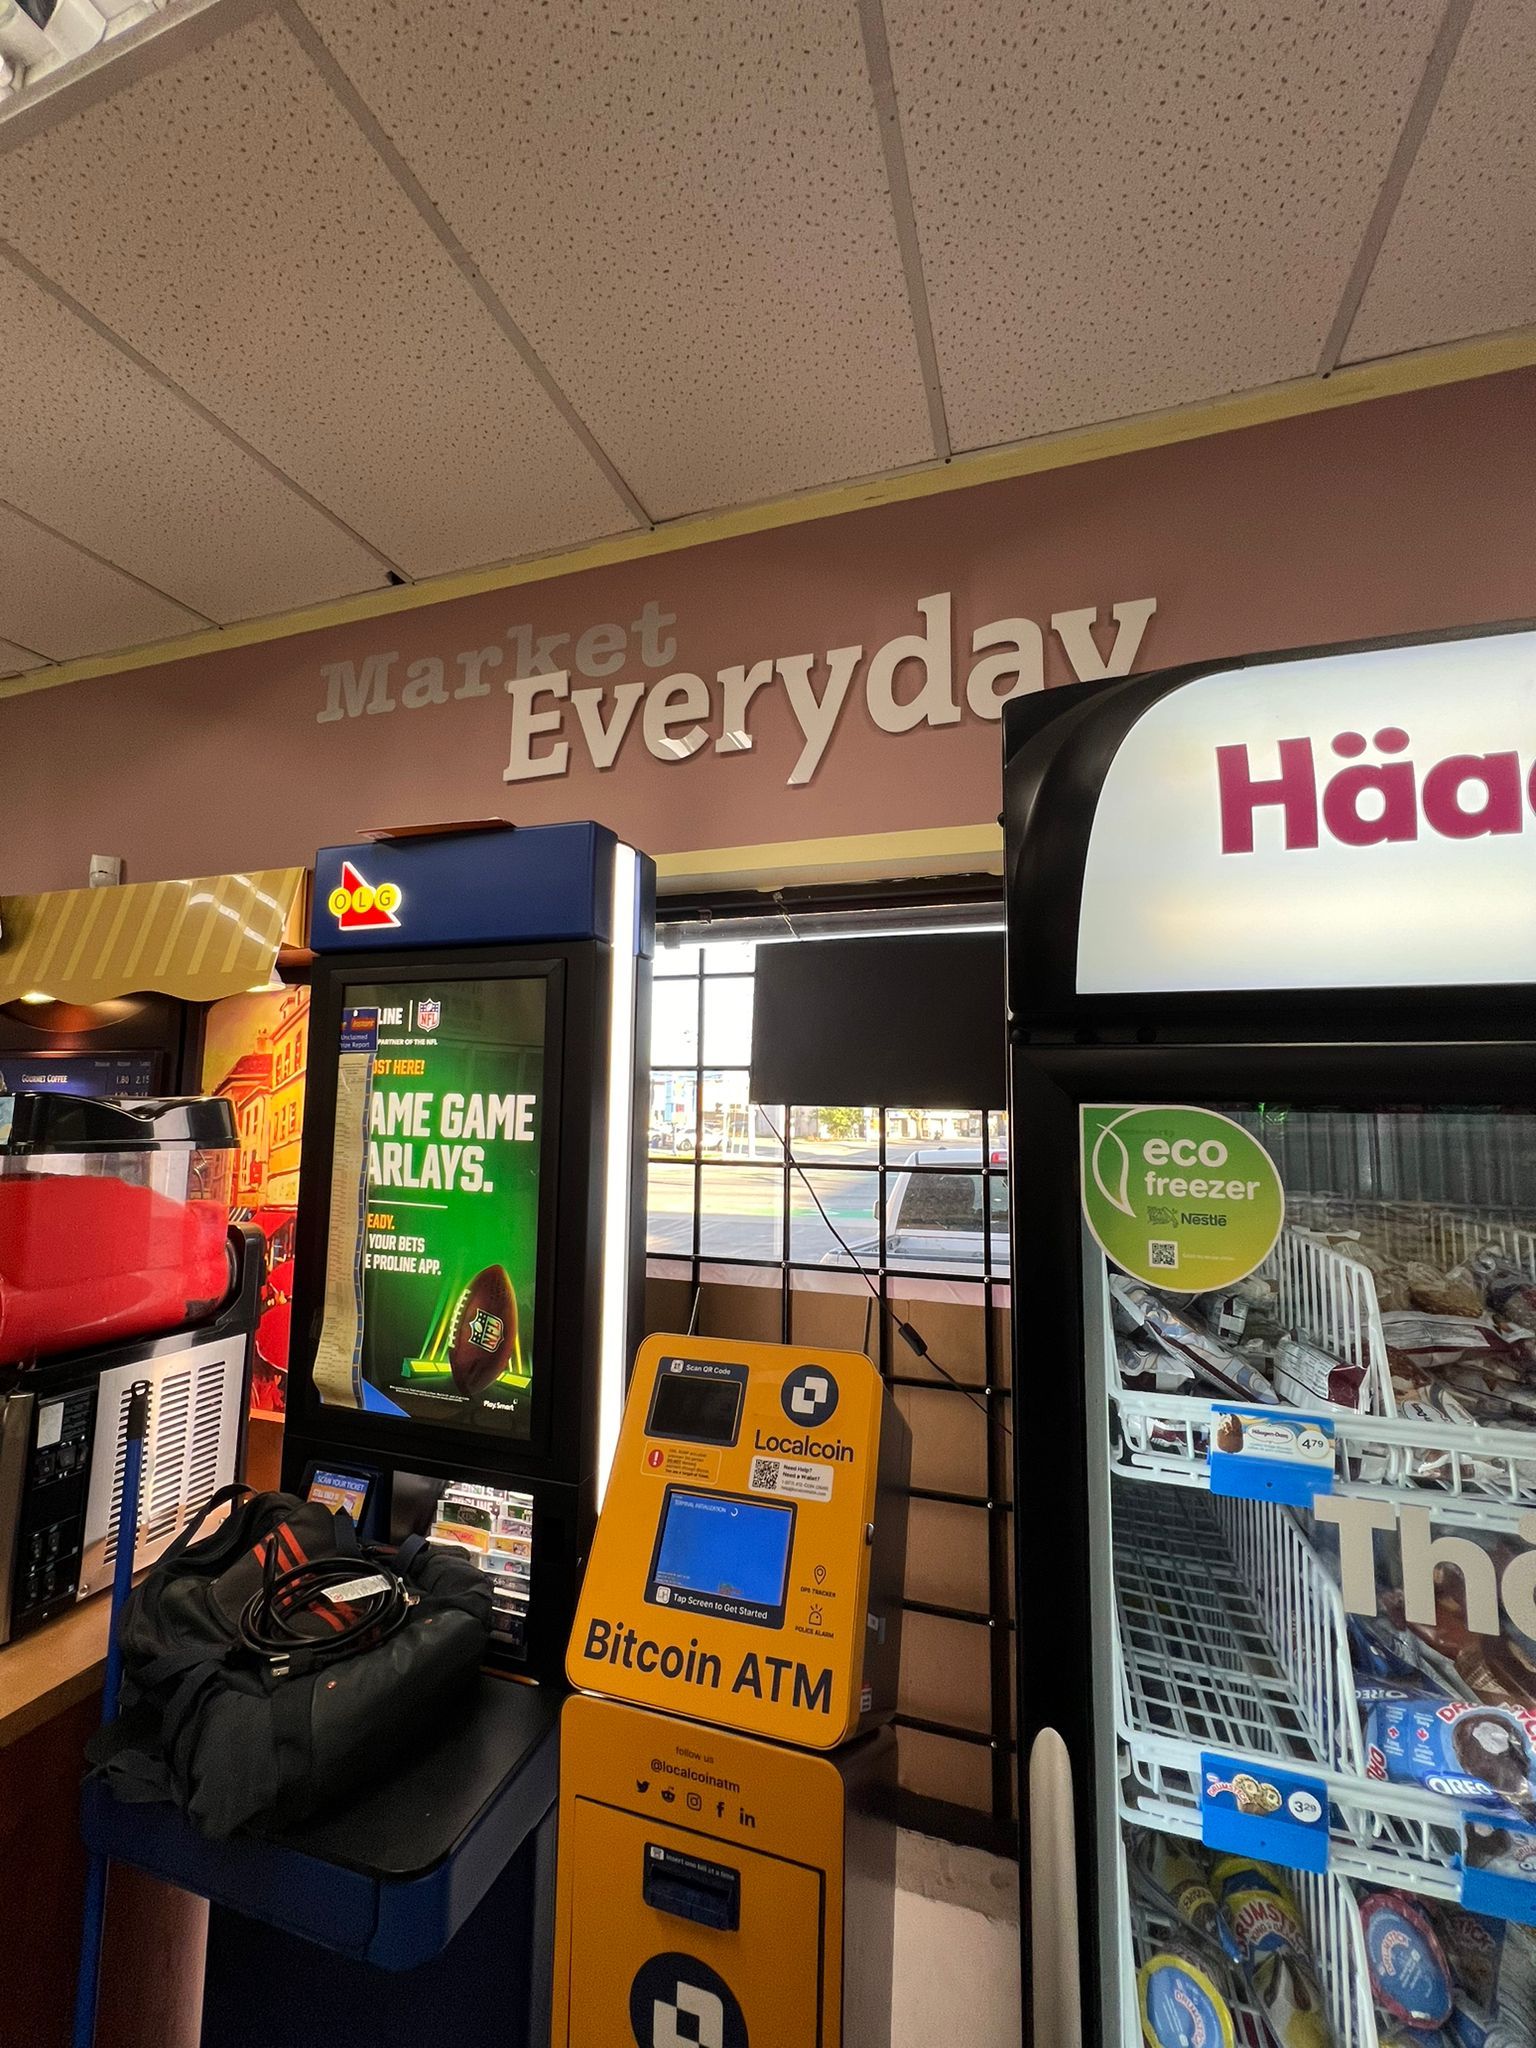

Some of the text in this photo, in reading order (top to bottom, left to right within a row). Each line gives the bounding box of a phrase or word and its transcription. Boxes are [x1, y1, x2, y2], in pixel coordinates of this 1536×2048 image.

[315, 601, 678, 725] Market
[1214, 726, 1536, 856] Häa
[334, 889, 391, 910] OLG
[421, 1012, 437, 1025] NFL
[393, 1060, 426, 1075] HERE!
[440, 1093, 537, 1142] GAME
[1142, 1138, 1229, 1168] eco
[368, 1142, 494, 1193] ARLAYS.
[1144, 1171, 1261, 1200] freezer
[369, 1233, 425, 1253] YOUR BETS
[373, 1254, 417, 1273] PROLINE
[418, 1258, 442, 1276] APP.
[686, 1363, 731, 1376] Scan QR Code
[754, 1430, 855, 1463] Localcoin
[317, 1475, 331, 1485] SCAN
[332, 1478, 347, 1488] YOUR
[812, 1588, 836, 1598] TRACKER
[673, 1593, 768, 1620] Tap Screen to Get Started
[795, 1626, 834, 1639] POLICE ALARM
[583, 1618, 833, 1715] Bitcoin ATM
[676, 1746, 714, 1764] follow us
[650, 1758, 740, 1793] @localcoinatm
[1428, 1777, 1494, 1796] OREO
[666, 1853, 684, 1865] Insert
